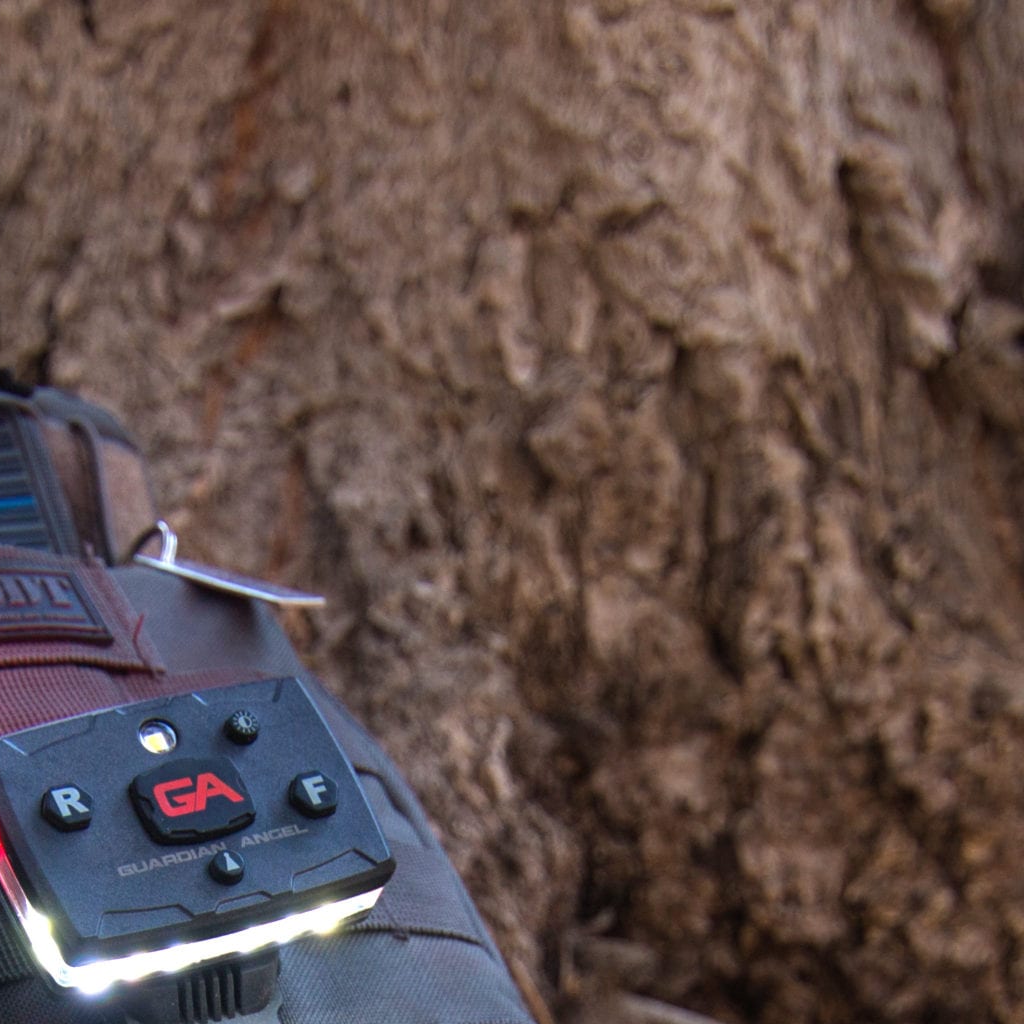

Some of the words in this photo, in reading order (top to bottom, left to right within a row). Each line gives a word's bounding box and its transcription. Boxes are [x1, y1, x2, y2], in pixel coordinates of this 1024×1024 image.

[50, 787, 90, 818] R
[152, 771, 245, 818] GA
[301, 775, 328, 805] F
[116, 841, 226, 878] GUARDIAN
[240, 823, 309, 848] ANGEL
